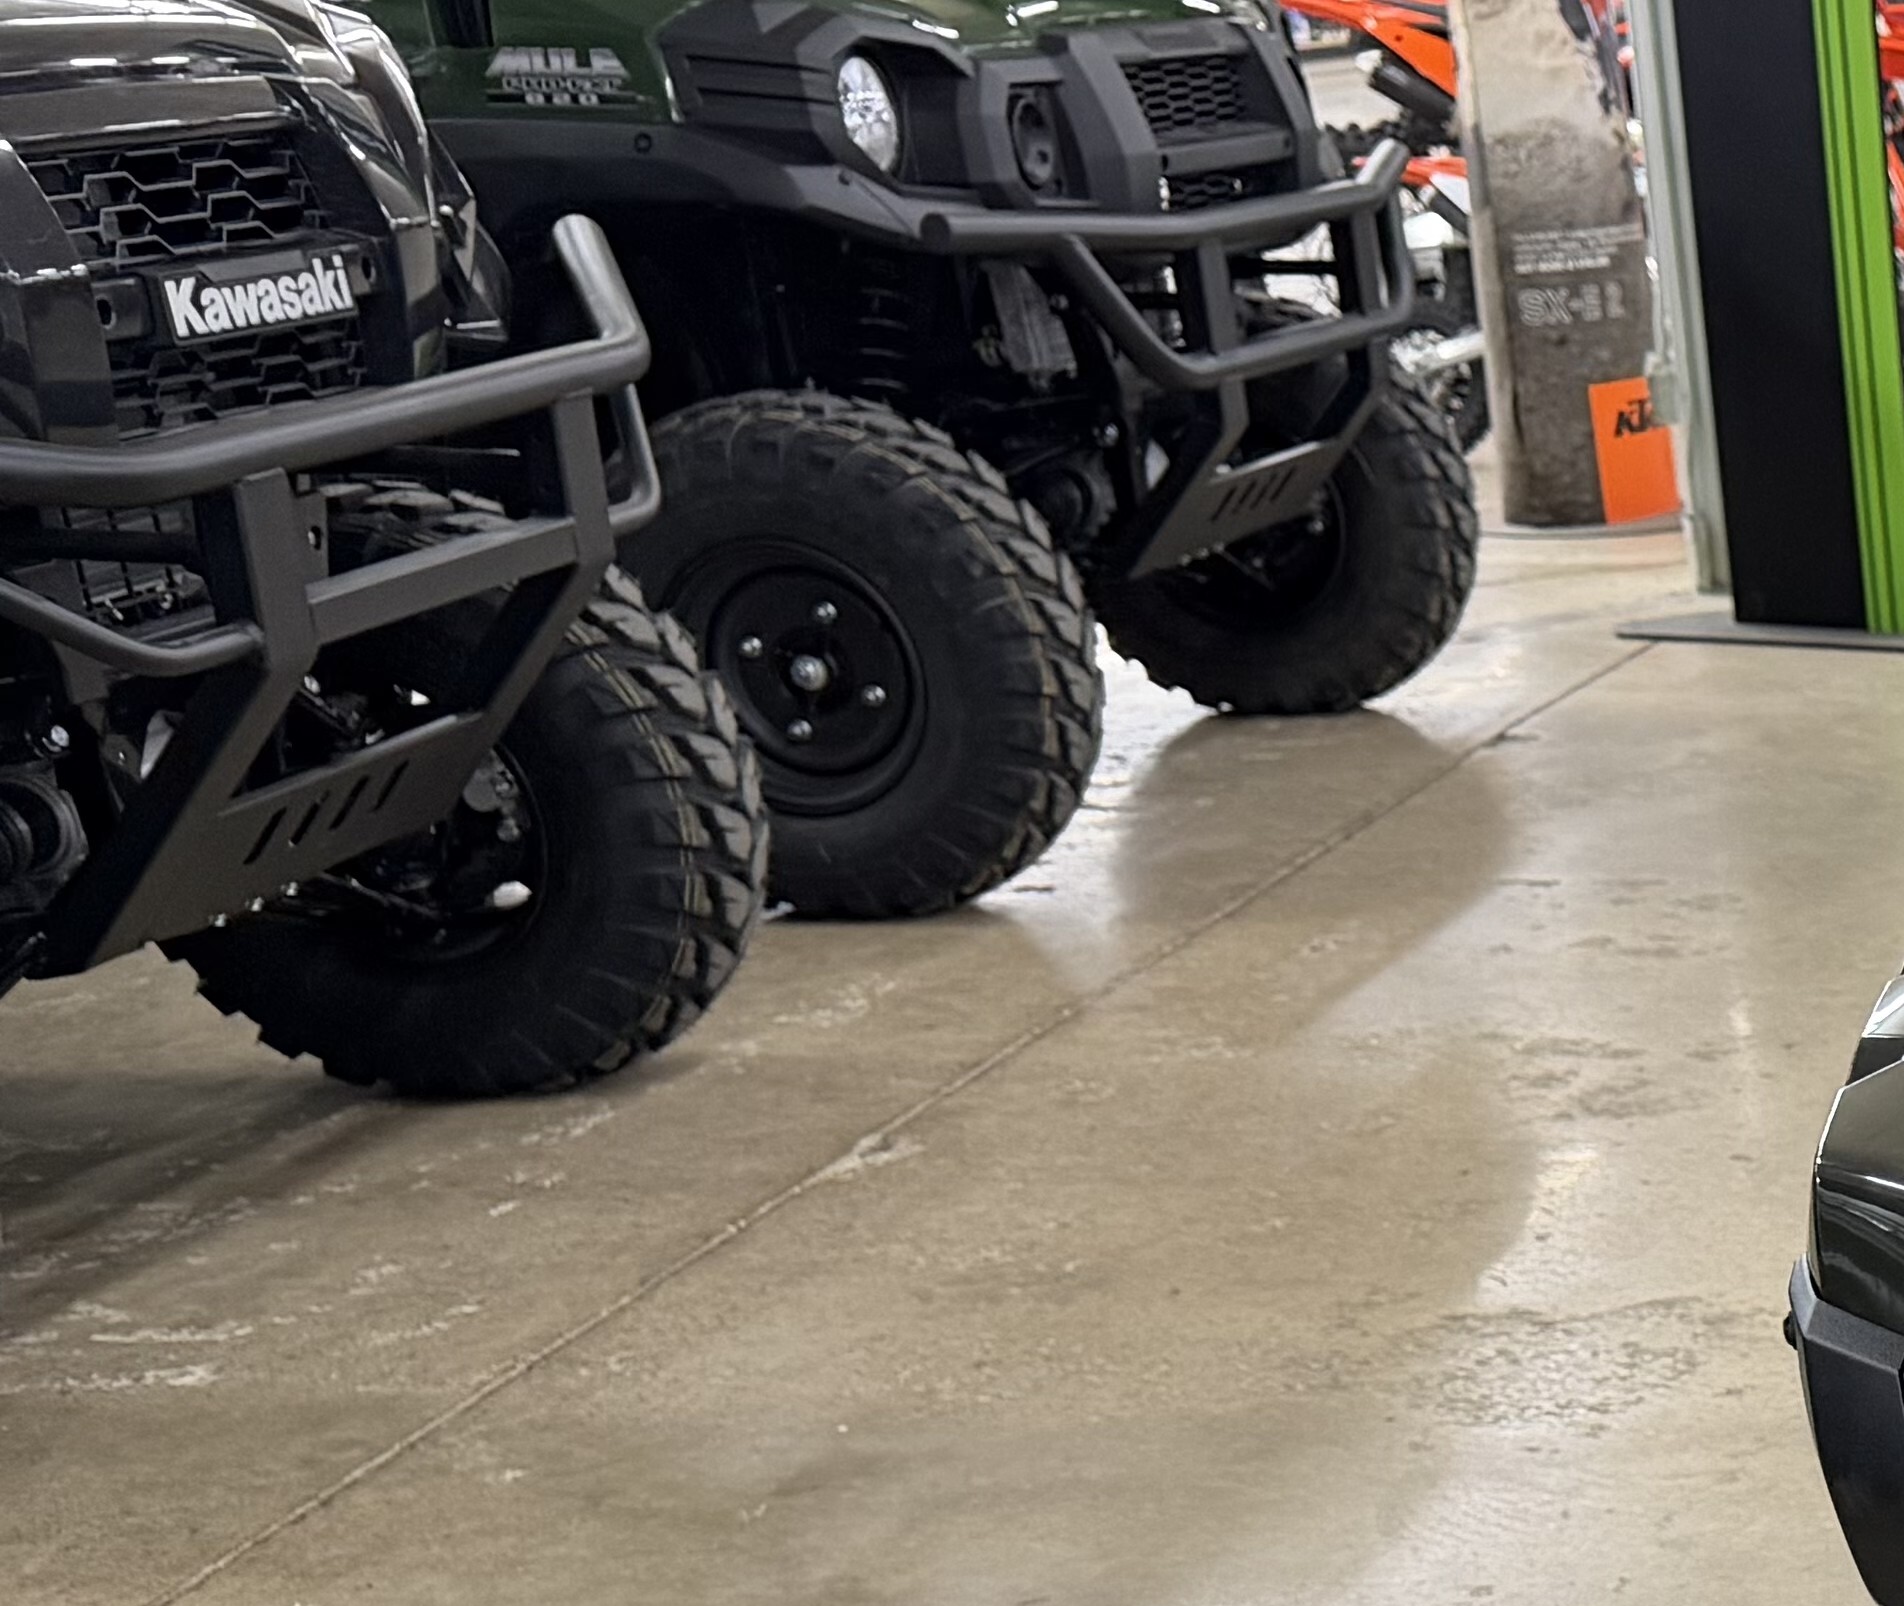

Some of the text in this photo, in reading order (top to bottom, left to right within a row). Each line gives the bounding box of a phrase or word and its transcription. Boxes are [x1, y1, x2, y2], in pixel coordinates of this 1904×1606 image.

[485, 46, 631, 77] MULE
[164, 254, 354, 338] Kawasaki
[1613, 398, 1650, 438] KT
